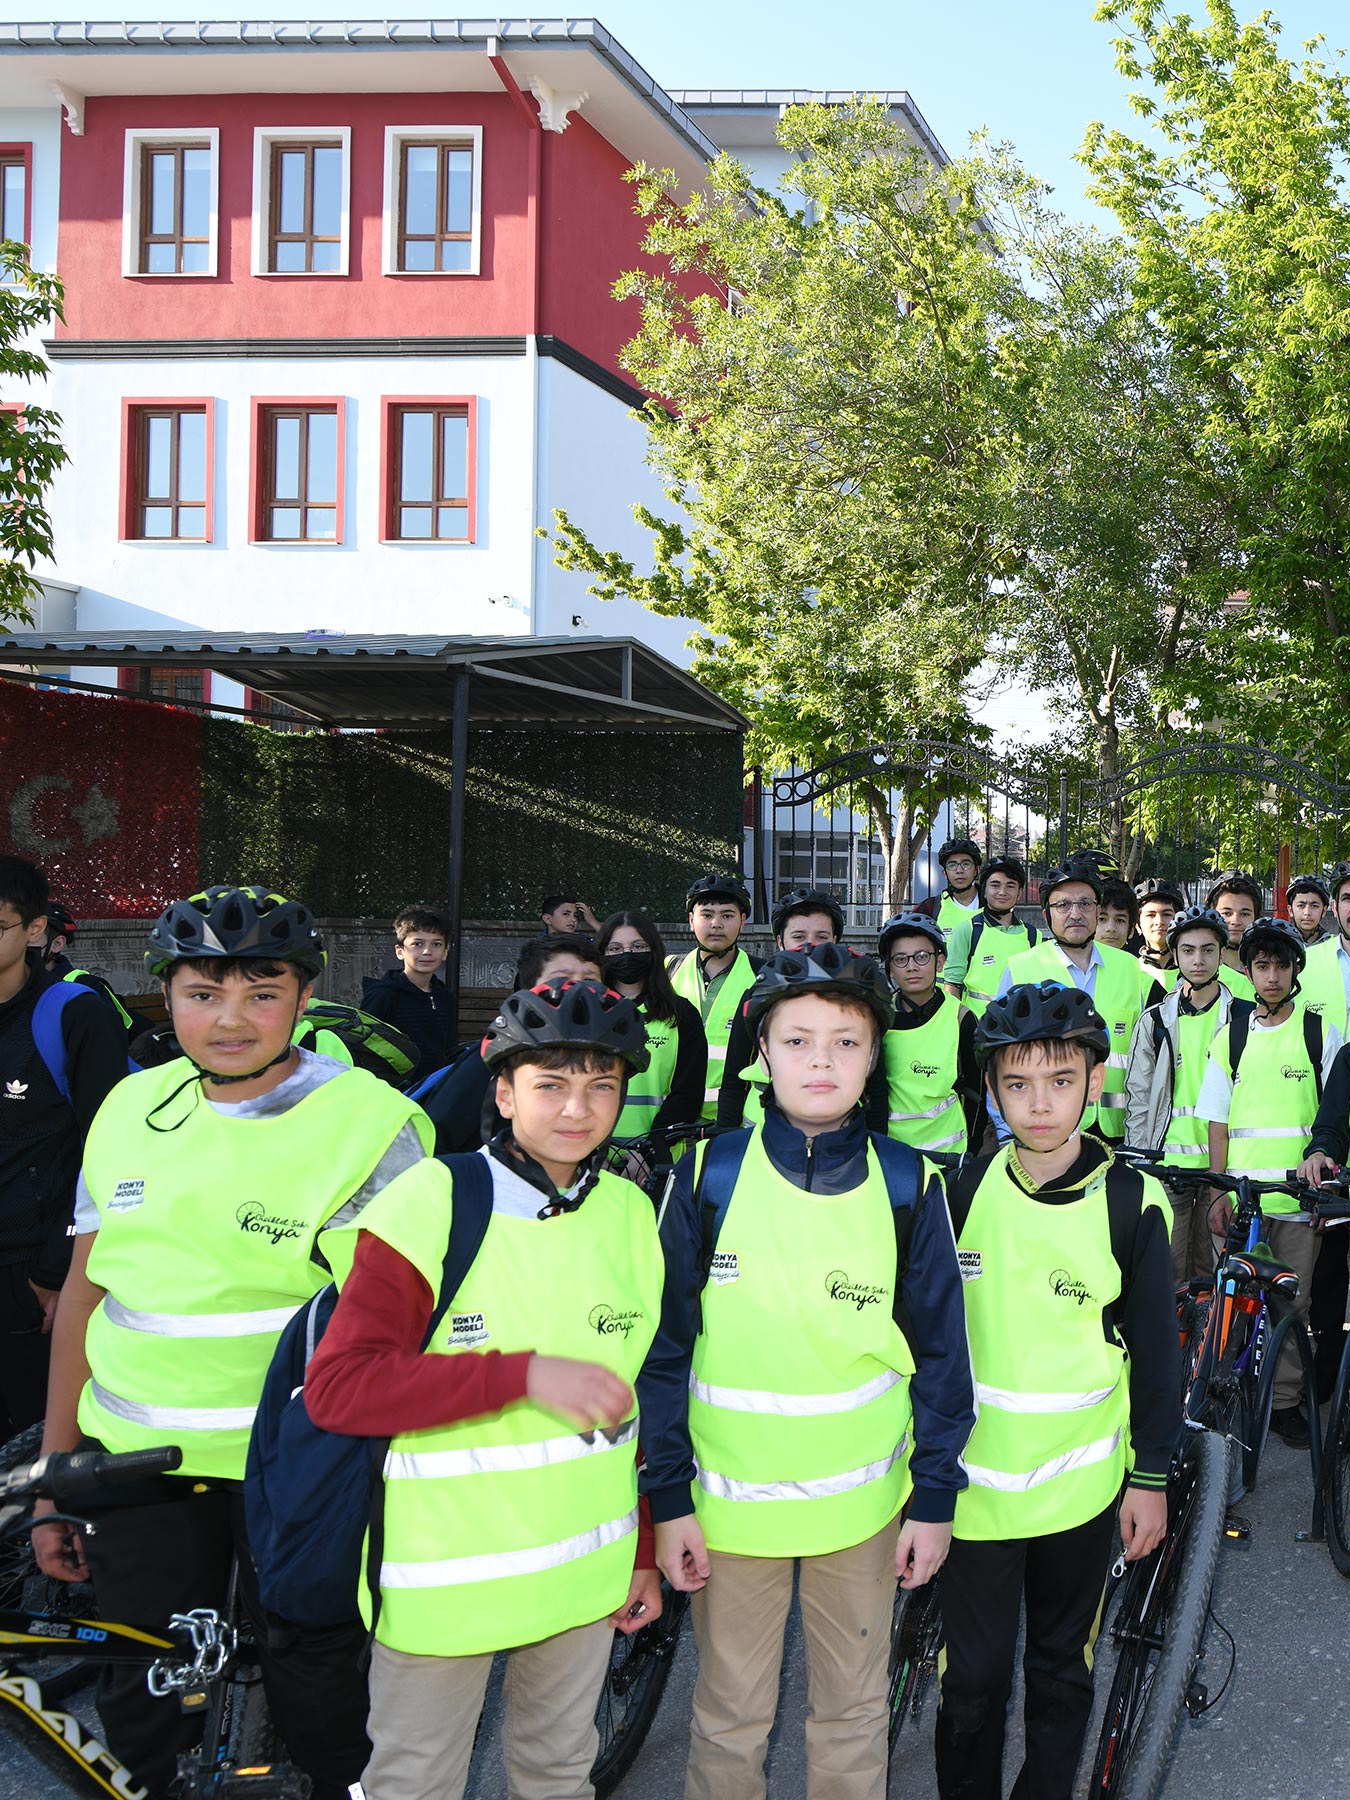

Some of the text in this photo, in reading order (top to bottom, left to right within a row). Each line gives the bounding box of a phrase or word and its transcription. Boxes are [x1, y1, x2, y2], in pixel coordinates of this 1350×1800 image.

[117, 1180, 145, 1190] KONYA
[240, 1211, 300, 1245] Konya
[830, 1281, 881, 1311] Konya
[452, 1314, 483, 1325] KONYA
[75, 1627, 108, 1643] 100
